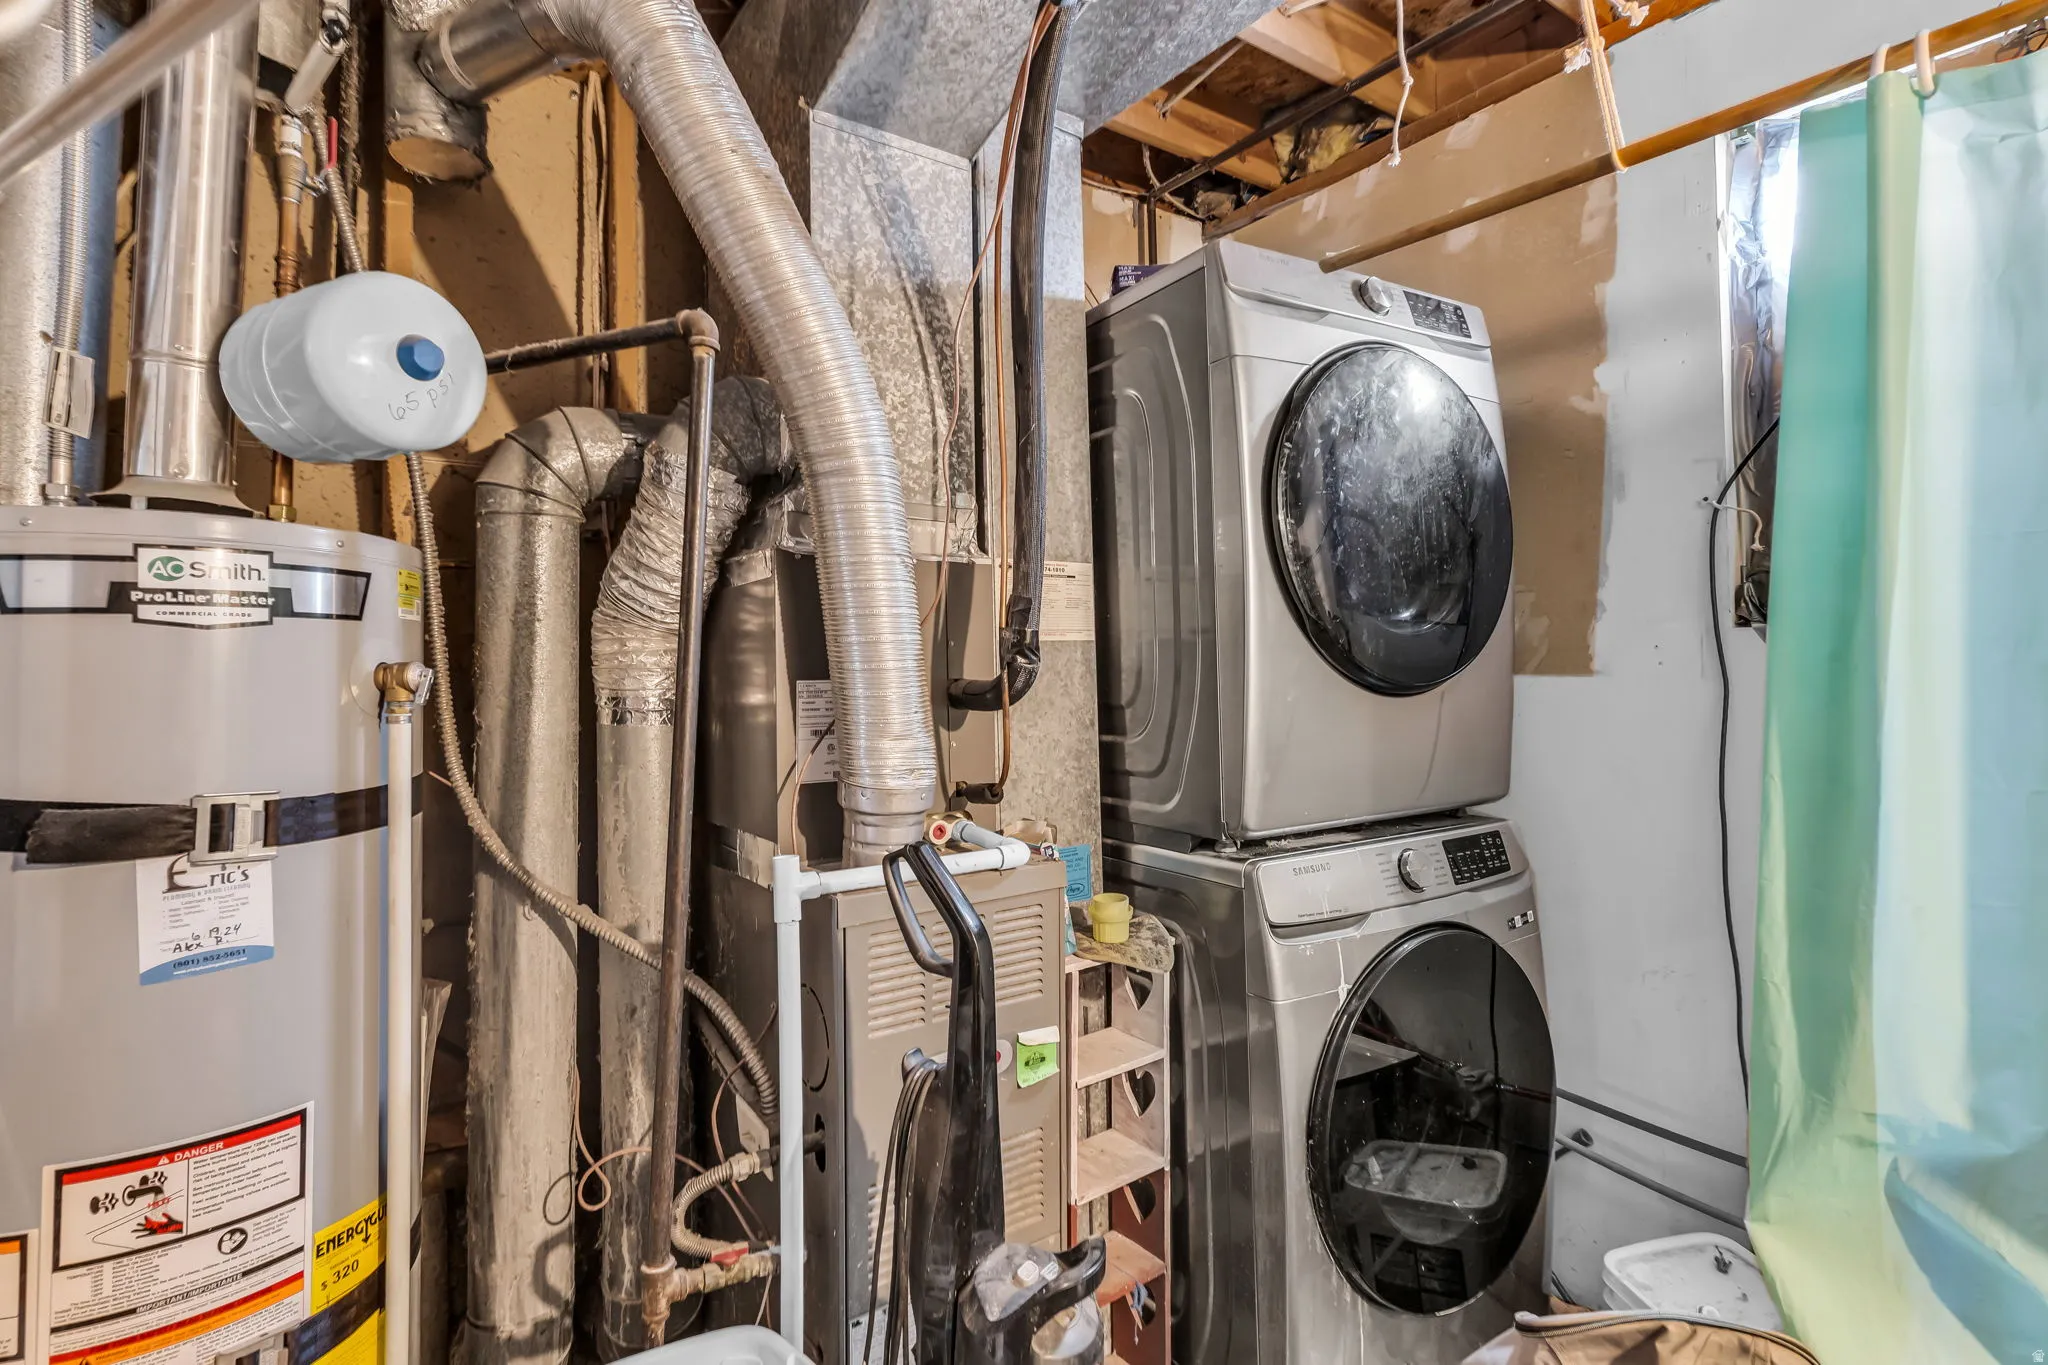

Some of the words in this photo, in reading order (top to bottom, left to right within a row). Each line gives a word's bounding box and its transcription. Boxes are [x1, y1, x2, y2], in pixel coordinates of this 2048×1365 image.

[388, 391, 420, 420] 65
[427, 372, 455, 408] psi
[162, 853, 250, 894] Eric's
[1292, 862, 1332, 877] SAMSUNG
[172, 941, 204, 954] Alex
[174, 1141, 224, 1163] DANGER
[332, 1259, 360, 1285] 320
